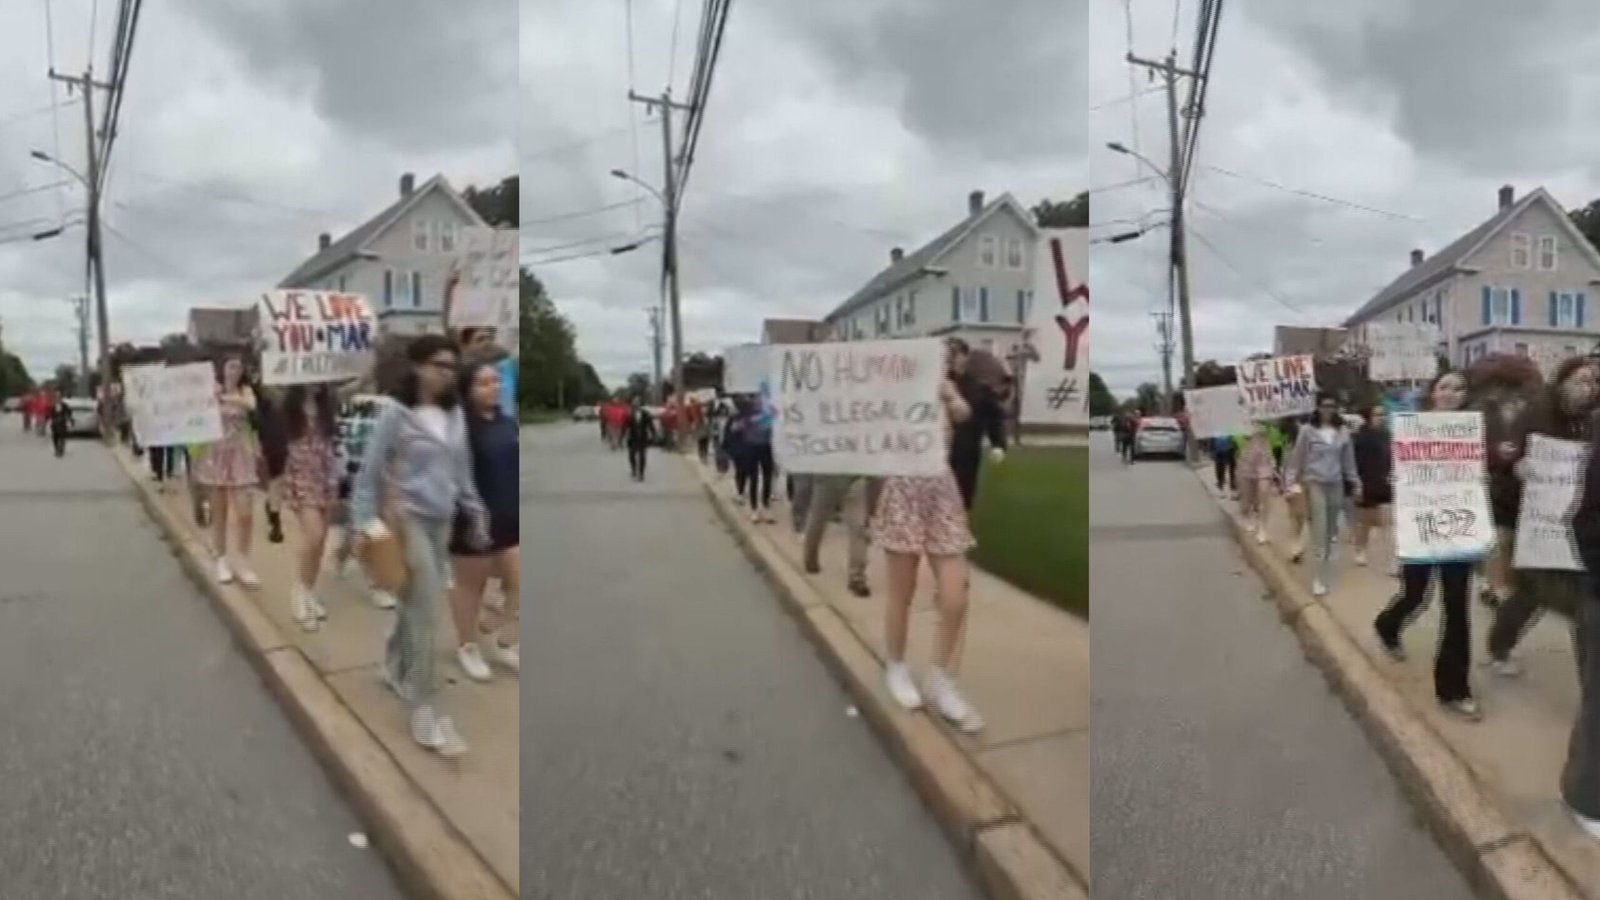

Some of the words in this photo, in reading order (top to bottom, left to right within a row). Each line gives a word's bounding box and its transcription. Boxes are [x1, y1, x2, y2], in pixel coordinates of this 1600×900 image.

[262, 292, 312, 320] WE
[272, 323, 314, 353] YOU
[781, 350, 824, 392] NO
[833, 351, 918, 387] HUMAN
[1239, 361, 1269, 384] WE
[782, 401, 805, 425] IS
[818, 400, 902, 426] ILLEGAL
[784, 432, 858, 456] STOLEN
[864, 429, 934, 455] LAND
